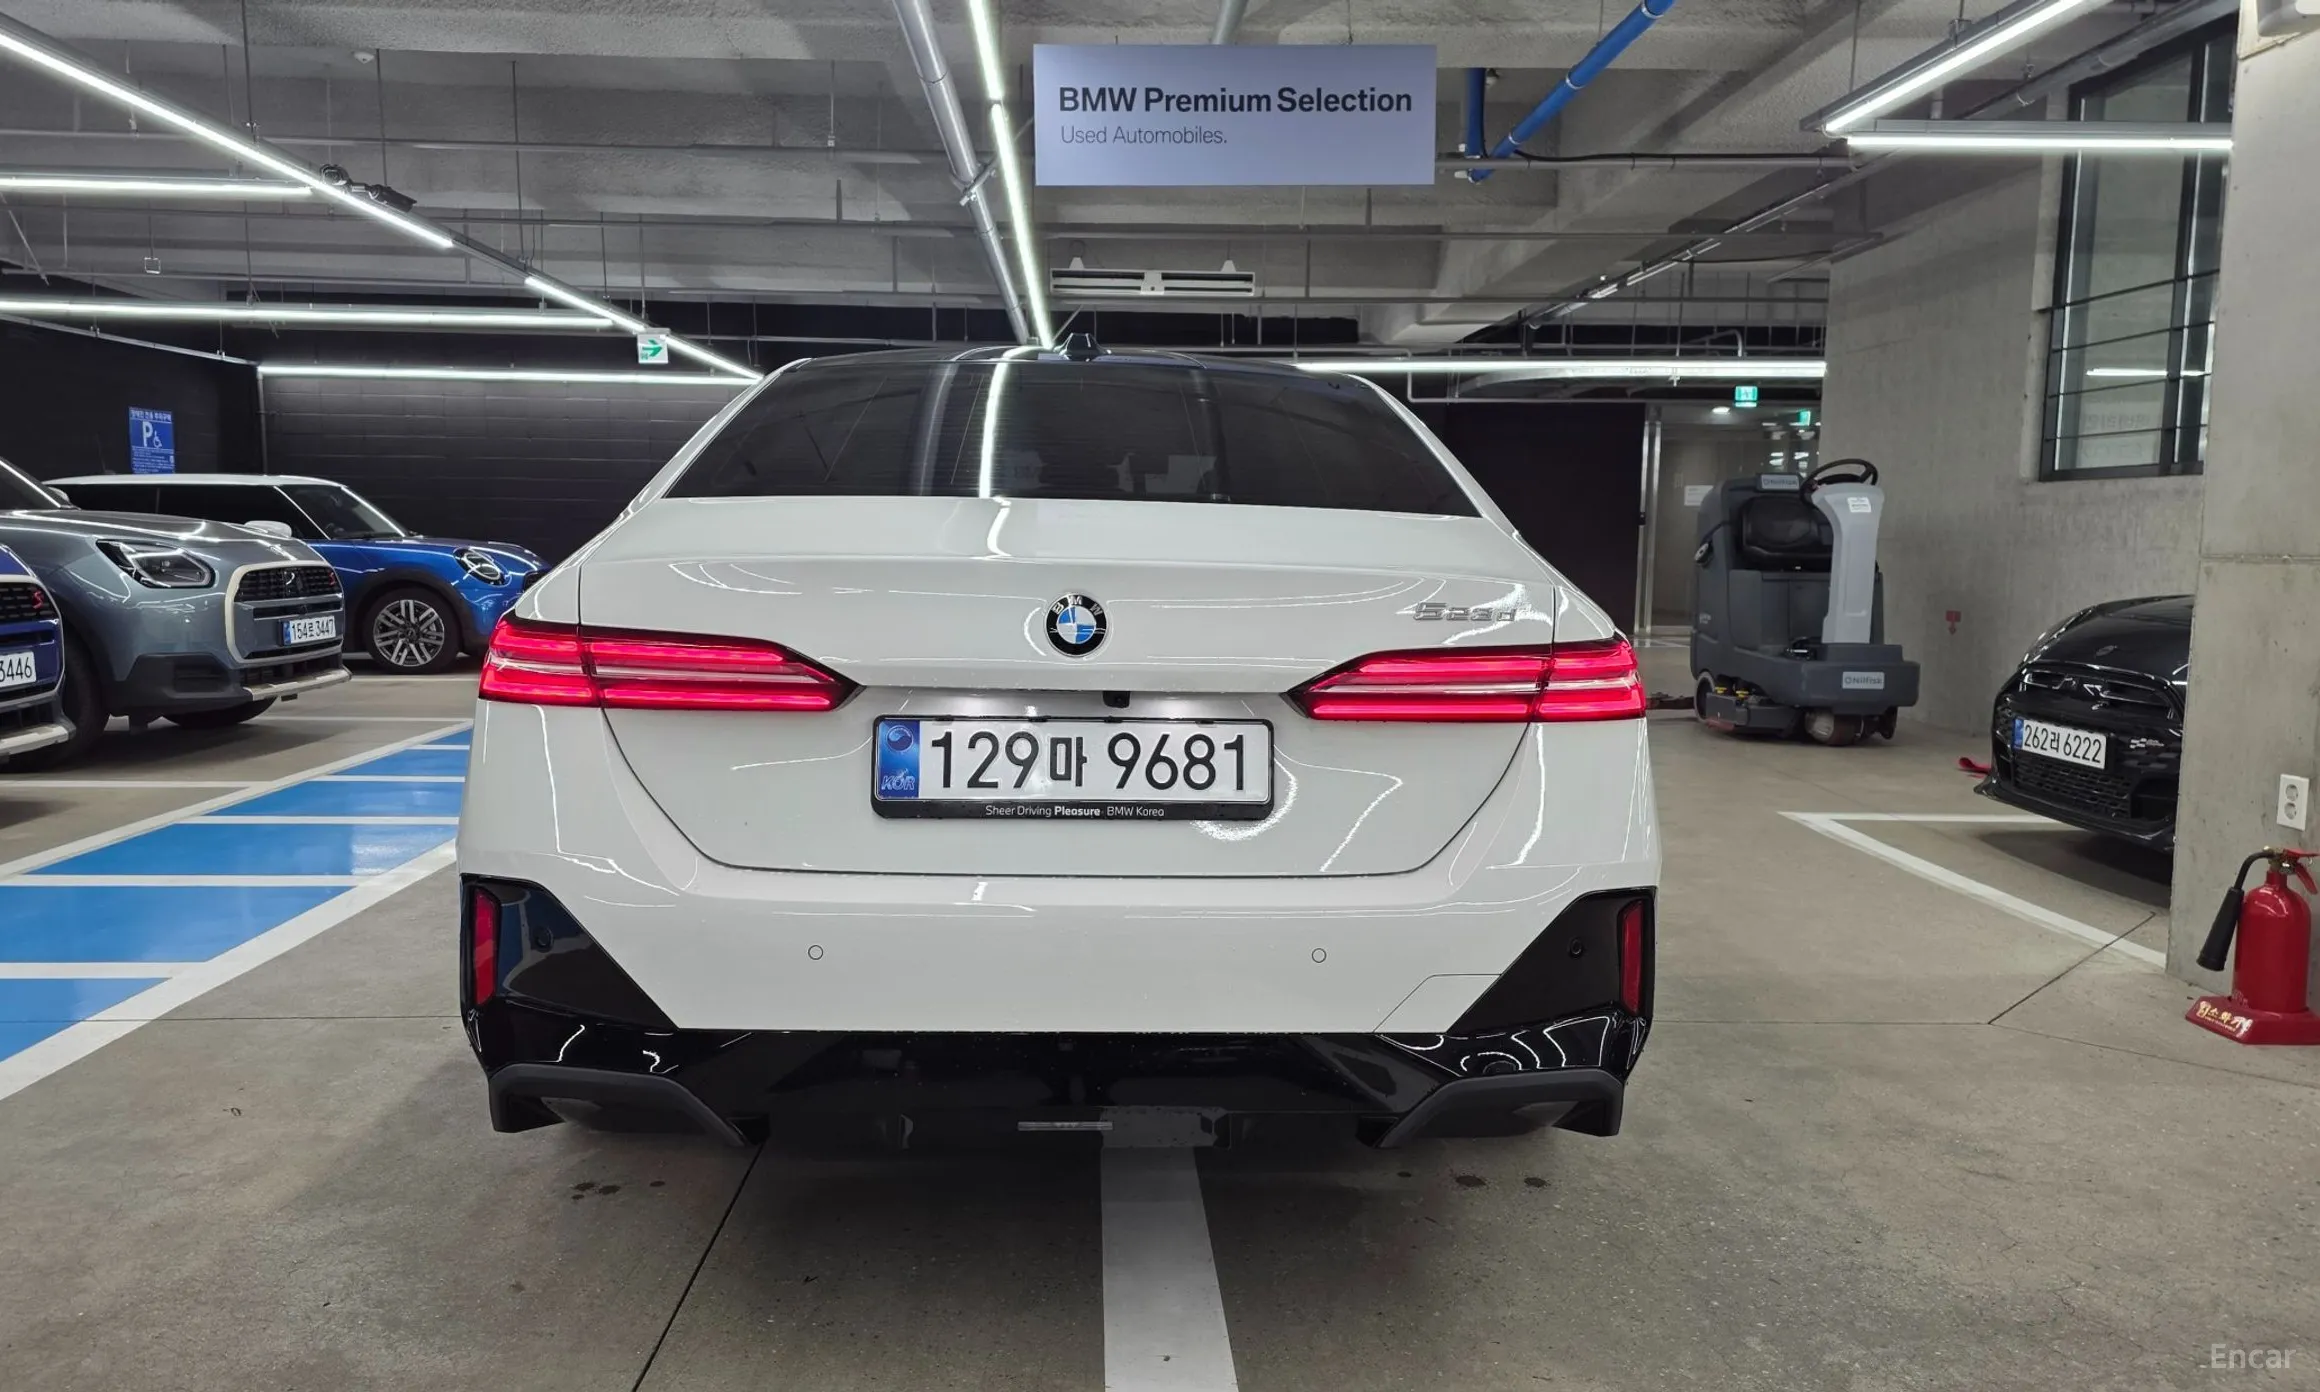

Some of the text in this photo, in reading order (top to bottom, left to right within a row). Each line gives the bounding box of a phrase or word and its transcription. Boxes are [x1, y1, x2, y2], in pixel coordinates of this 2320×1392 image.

[1059, 86, 1412, 113] BMW Premium Selection
[1060, 126, 1228, 144] Used Automobiles.
[142, 420, 154, 447] P
[315, 618, 335, 637] 3447
[0, 656, 33, 681] 3446
[931, 730, 1245, 791] 129마 9681
[2063, 733, 2102, 764] 6222
[880, 774, 917, 791] KOR
[985, 804, 1165, 818] Sheer Driving Pleasure BMW Korea
